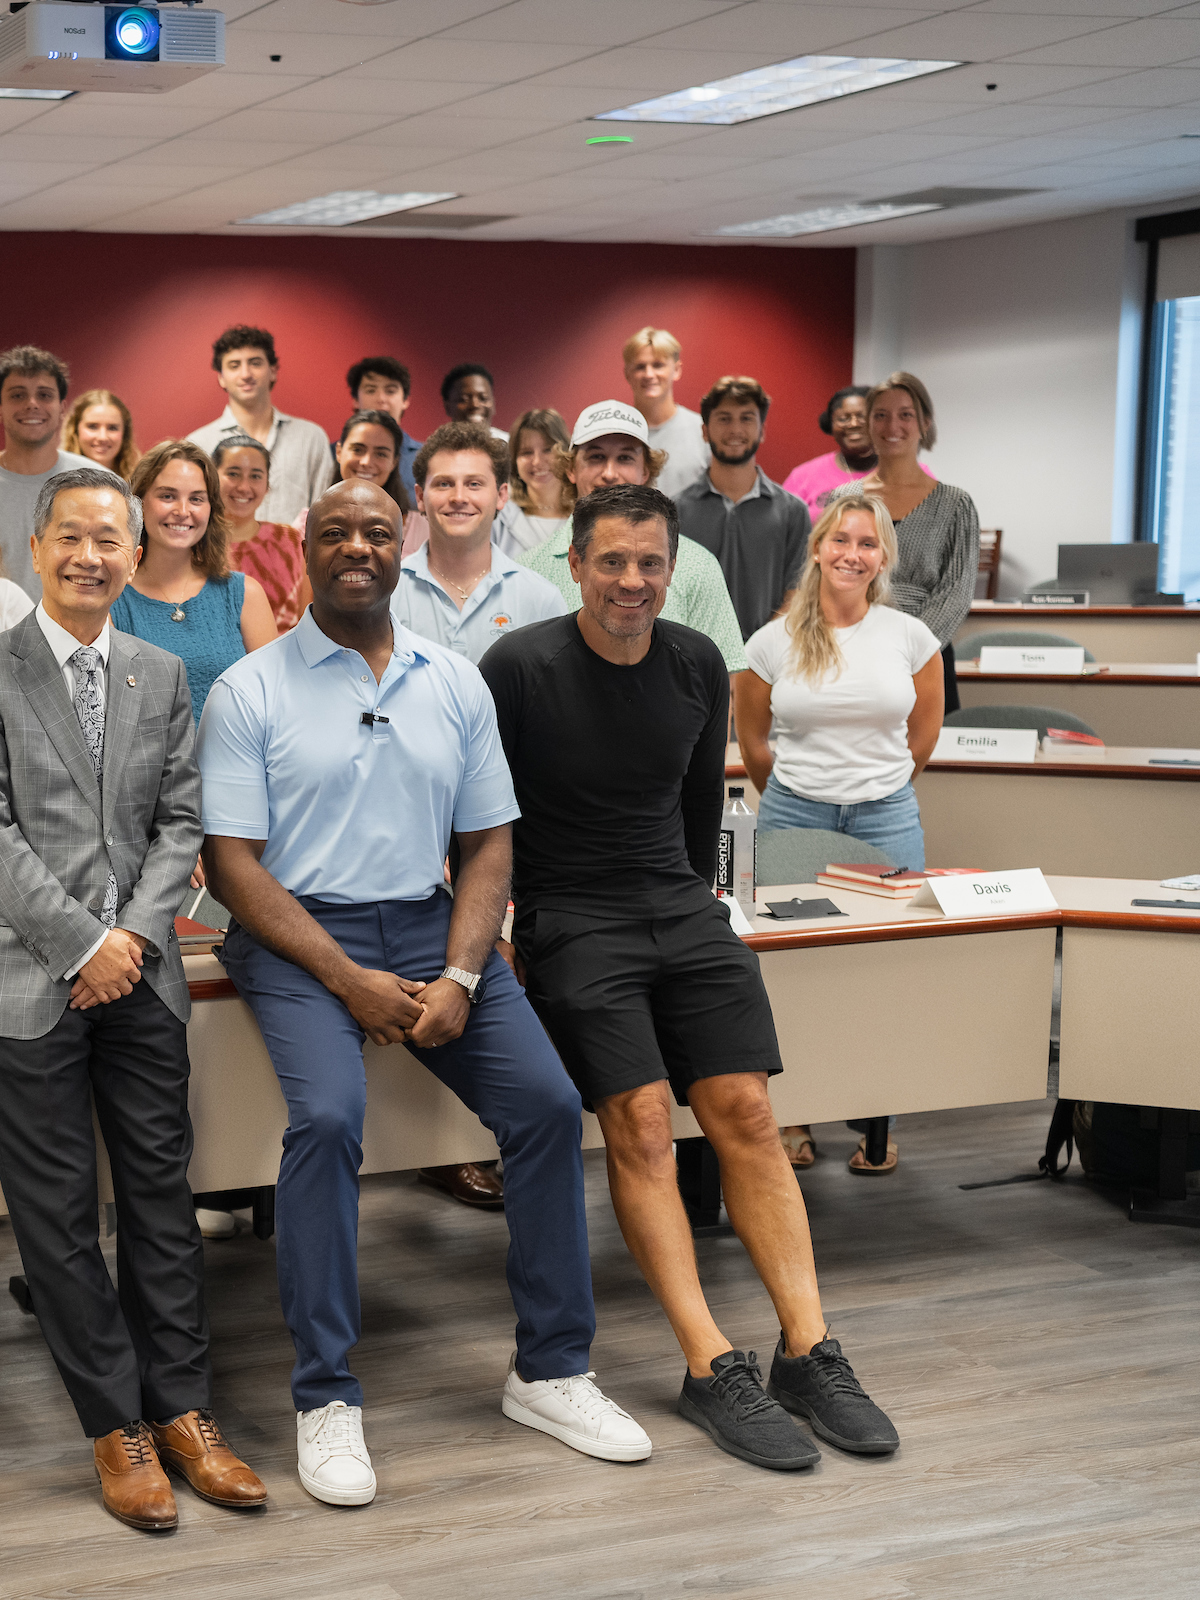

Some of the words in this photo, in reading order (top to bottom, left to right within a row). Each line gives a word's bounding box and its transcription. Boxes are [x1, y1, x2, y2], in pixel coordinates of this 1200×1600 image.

[64, 27, 86, 35] EPSON
[584, 407, 643, 428] Titleist
[957, 736, 998, 747] Emilia
[717, 832, 729, 885] essentia
[972, 881, 1012, 895] Davis
